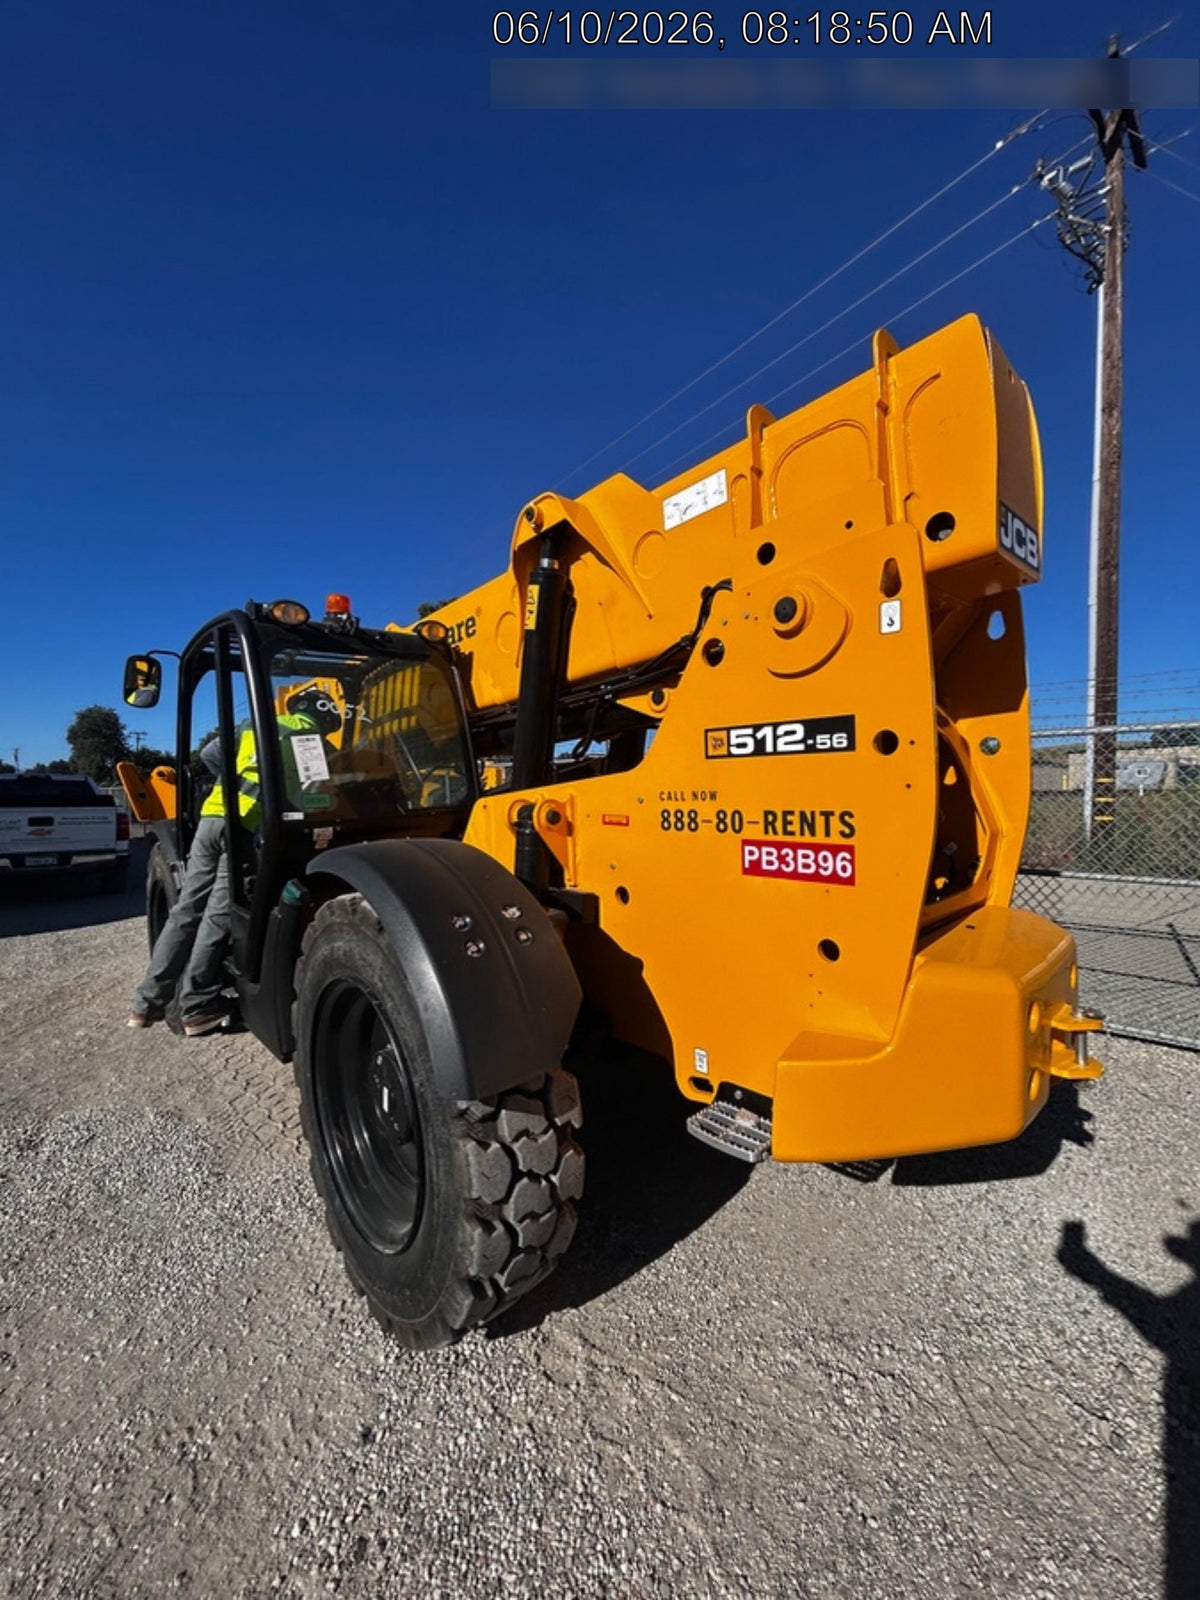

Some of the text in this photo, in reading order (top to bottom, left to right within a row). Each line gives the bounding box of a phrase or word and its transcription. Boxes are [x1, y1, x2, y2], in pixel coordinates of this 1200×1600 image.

[1001, 511, 1038, 568] JCB
[447, 616, 477, 643] are
[729, 723, 848, 755] 512-56
[659, 790, 718, 802] CALL NOW
[660, 808, 856, 839] 888-80-RENTS
[743, 845, 853, 878] PB3B96
